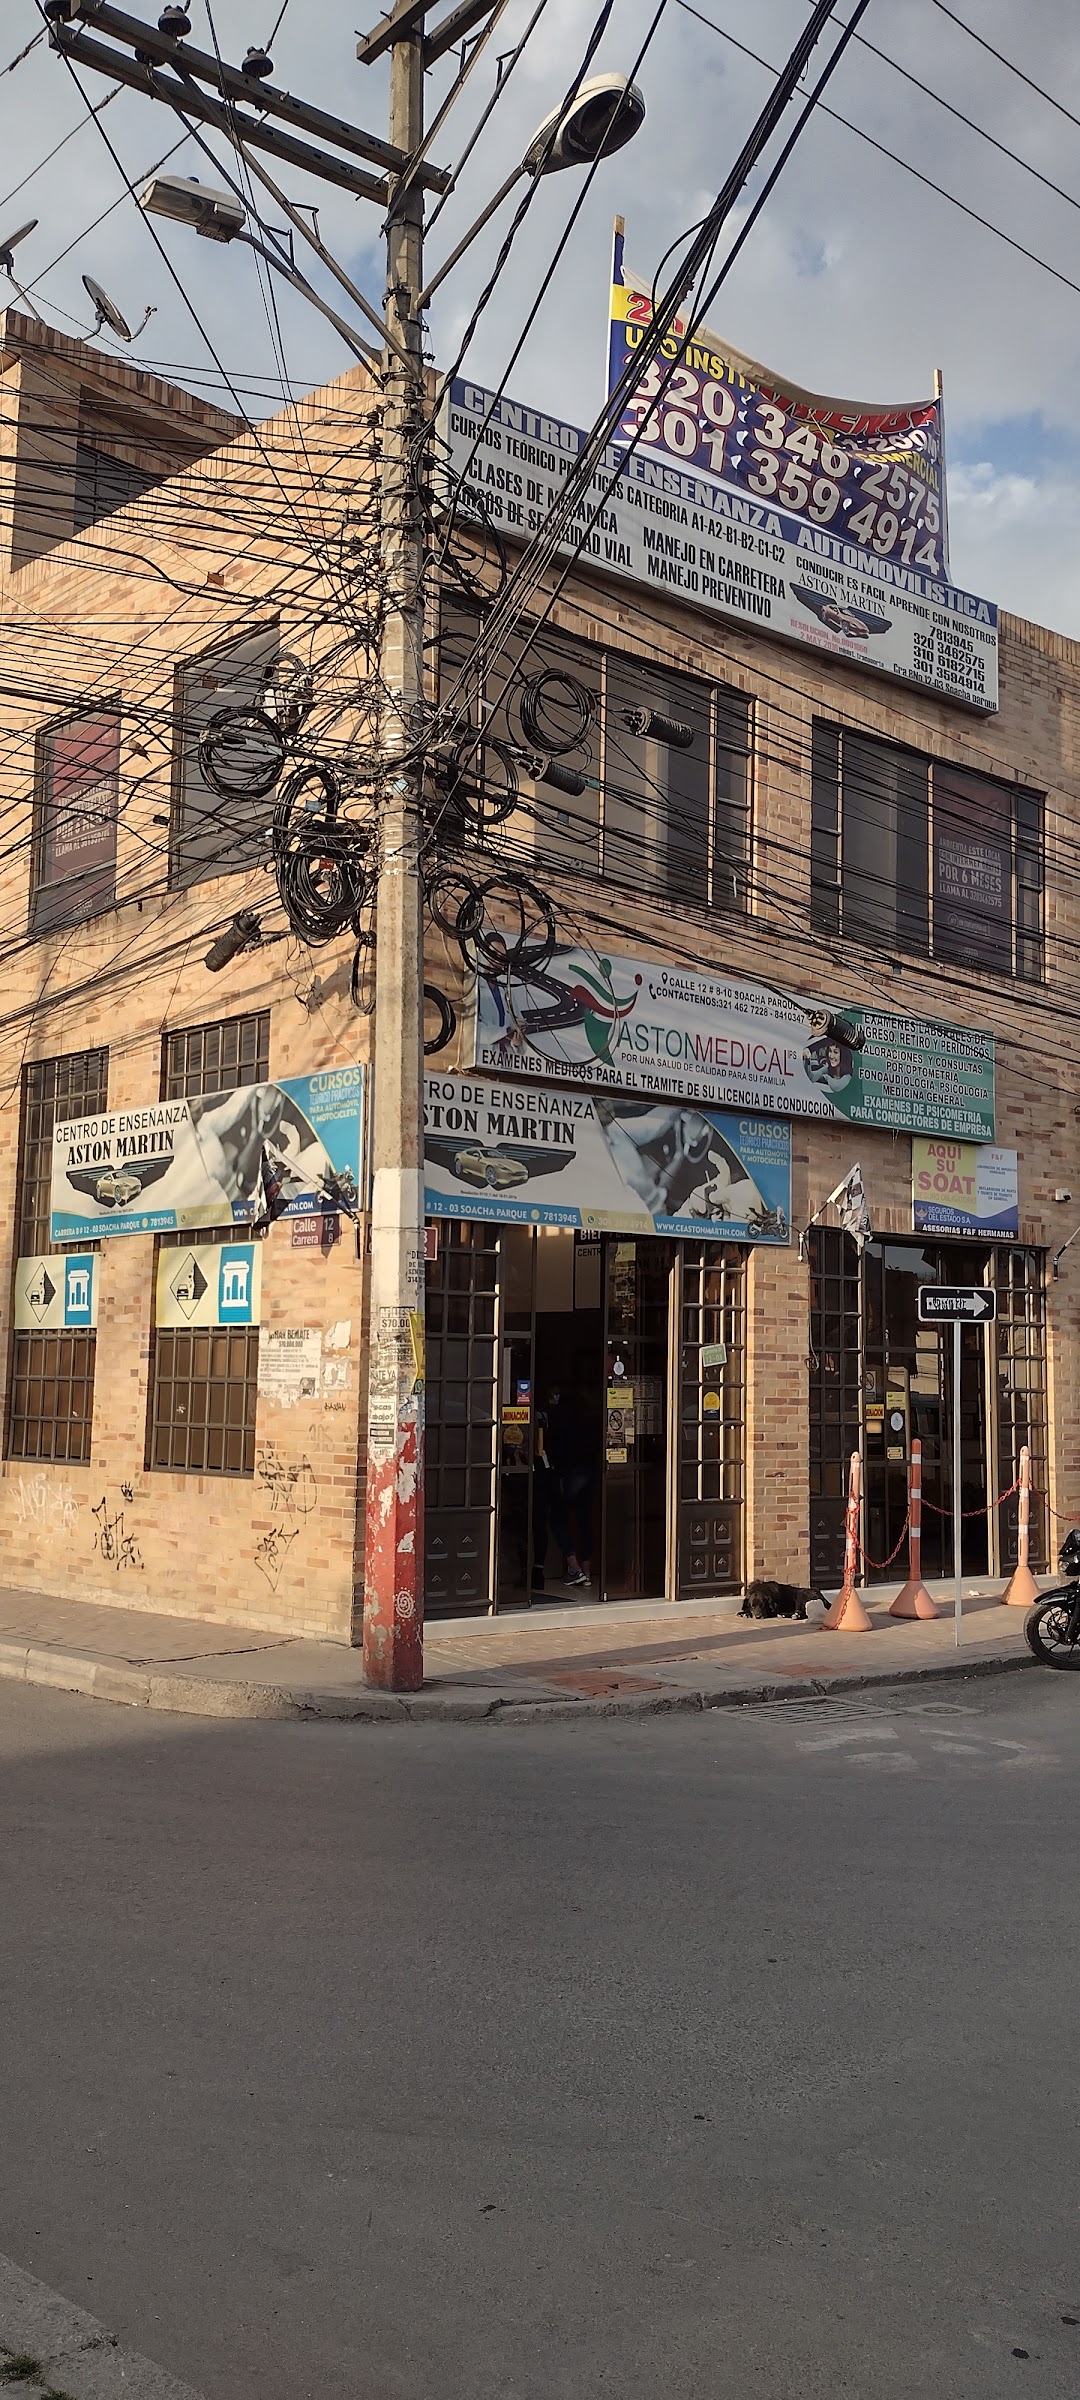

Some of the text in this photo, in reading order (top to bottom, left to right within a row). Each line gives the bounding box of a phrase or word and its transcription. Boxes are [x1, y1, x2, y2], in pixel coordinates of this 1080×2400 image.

[624, 354, 736, 426] 320
[755, 402, 850, 478] 346
[860, 461, 941, 534] 2575
[451, 412, 785, 559] CURSOS TEÓRICO CATEGORIA A1-A2-B1-B2-C1-C2
[469, 456, 544, 505] CLASES DE
[621, 397, 727, 473] 301
[748, 447, 841, 524] 359
[847, 501, 940, 576] 4914
[464, 385, 580, 454] CENTRO
[797, 526, 991, 624] AUTOMOVILISTICA
[507, 505, 633, 568] DE VIAL
[643, 526, 786, 600] MANEJO EN CARRETERA
[648, 554, 771, 618] MANEJO PREVENTIVO
[799, 572, 886, 617] ASTON MARTIN
[796, 555, 996, 646] CONDUCIR ES FACIL APRENDE CON NOSOTROS
[914, 632, 934, 650] 320
[930, 626, 974, 653] 7813945
[914, 645, 934, 662] 310
[914, 658, 933, 675] 301
[969, 846, 984, 856] ESTE
[939, 862, 958, 881] POR
[962, 870, 968, 883] 6
[971, 871, 1001, 892] MESES
[940, 883, 960, 896] LLAMA
[961, 888, 969, 898] AL
[669, 977, 798, 1011] CALLE 12 # 8-10 SOACHA PARQUE
[734, 1003, 748, 1013] 462
[750, 1006, 768, 1018] 7228
[774, 1011, 805, 1024] 8410347
[900, 1033, 931, 1050] RETIRO
[933, 1039, 939, 1050] Y
[621, 1053, 786, 1087] POR UNA SALUD DE CALIDAD PARA SU FAMILIA
[886, 1062, 959, 1082] POR OPTOMETRIA
[928, 1054, 983, 1074] Y CONSULTAS
[309, 1068, 361, 1093] CURSOS
[482, 1048, 835, 1117] EXAMENES MEDICOS PARA EL TRAMITE DE SU LICENCIA DE CONDUCCION
[939, 1082, 989, 1099] PSICOLOGIA
[462, 1085, 484, 1105] DE
[491, 1090, 594, 1120] ENSEÑANZA
[882, 1085, 965, 1107] MEDICINA GENERAL
[850, 1105, 992, 1137] PARA CONDUCTORES DE EMPRESA
[864, 1095, 982, 1124] EXAMENES DE PSICOMETRIA
[56, 1105, 189, 1143] CENTRO DE ENSEÑANZA
[487, 1112, 575, 1145] MARTIN
[739, 1120, 789, 1140] CURSOS
[67, 1129, 175, 1166] ASTON MARTIN
[936, 1159, 955, 1173] SU
[918, 1171, 975, 1195] SOAT
[433, 1202, 578, 1223] 12 03 SOACHA PARQUE 7813945
[928, 1206, 954, 1214] SEGUROS
[940, 1215, 960, 1223] ESTADO
[294, 1218, 334, 1233] Calle 12
[656, 1222, 746, 1237] WWW.CEASTONMARTIN.COM
[923, 1224, 960, 1234] ASESORIAS
[978, 1229, 1014, 1238] HERMANAS
[292, 1232, 333, 1245] Carrera 8
